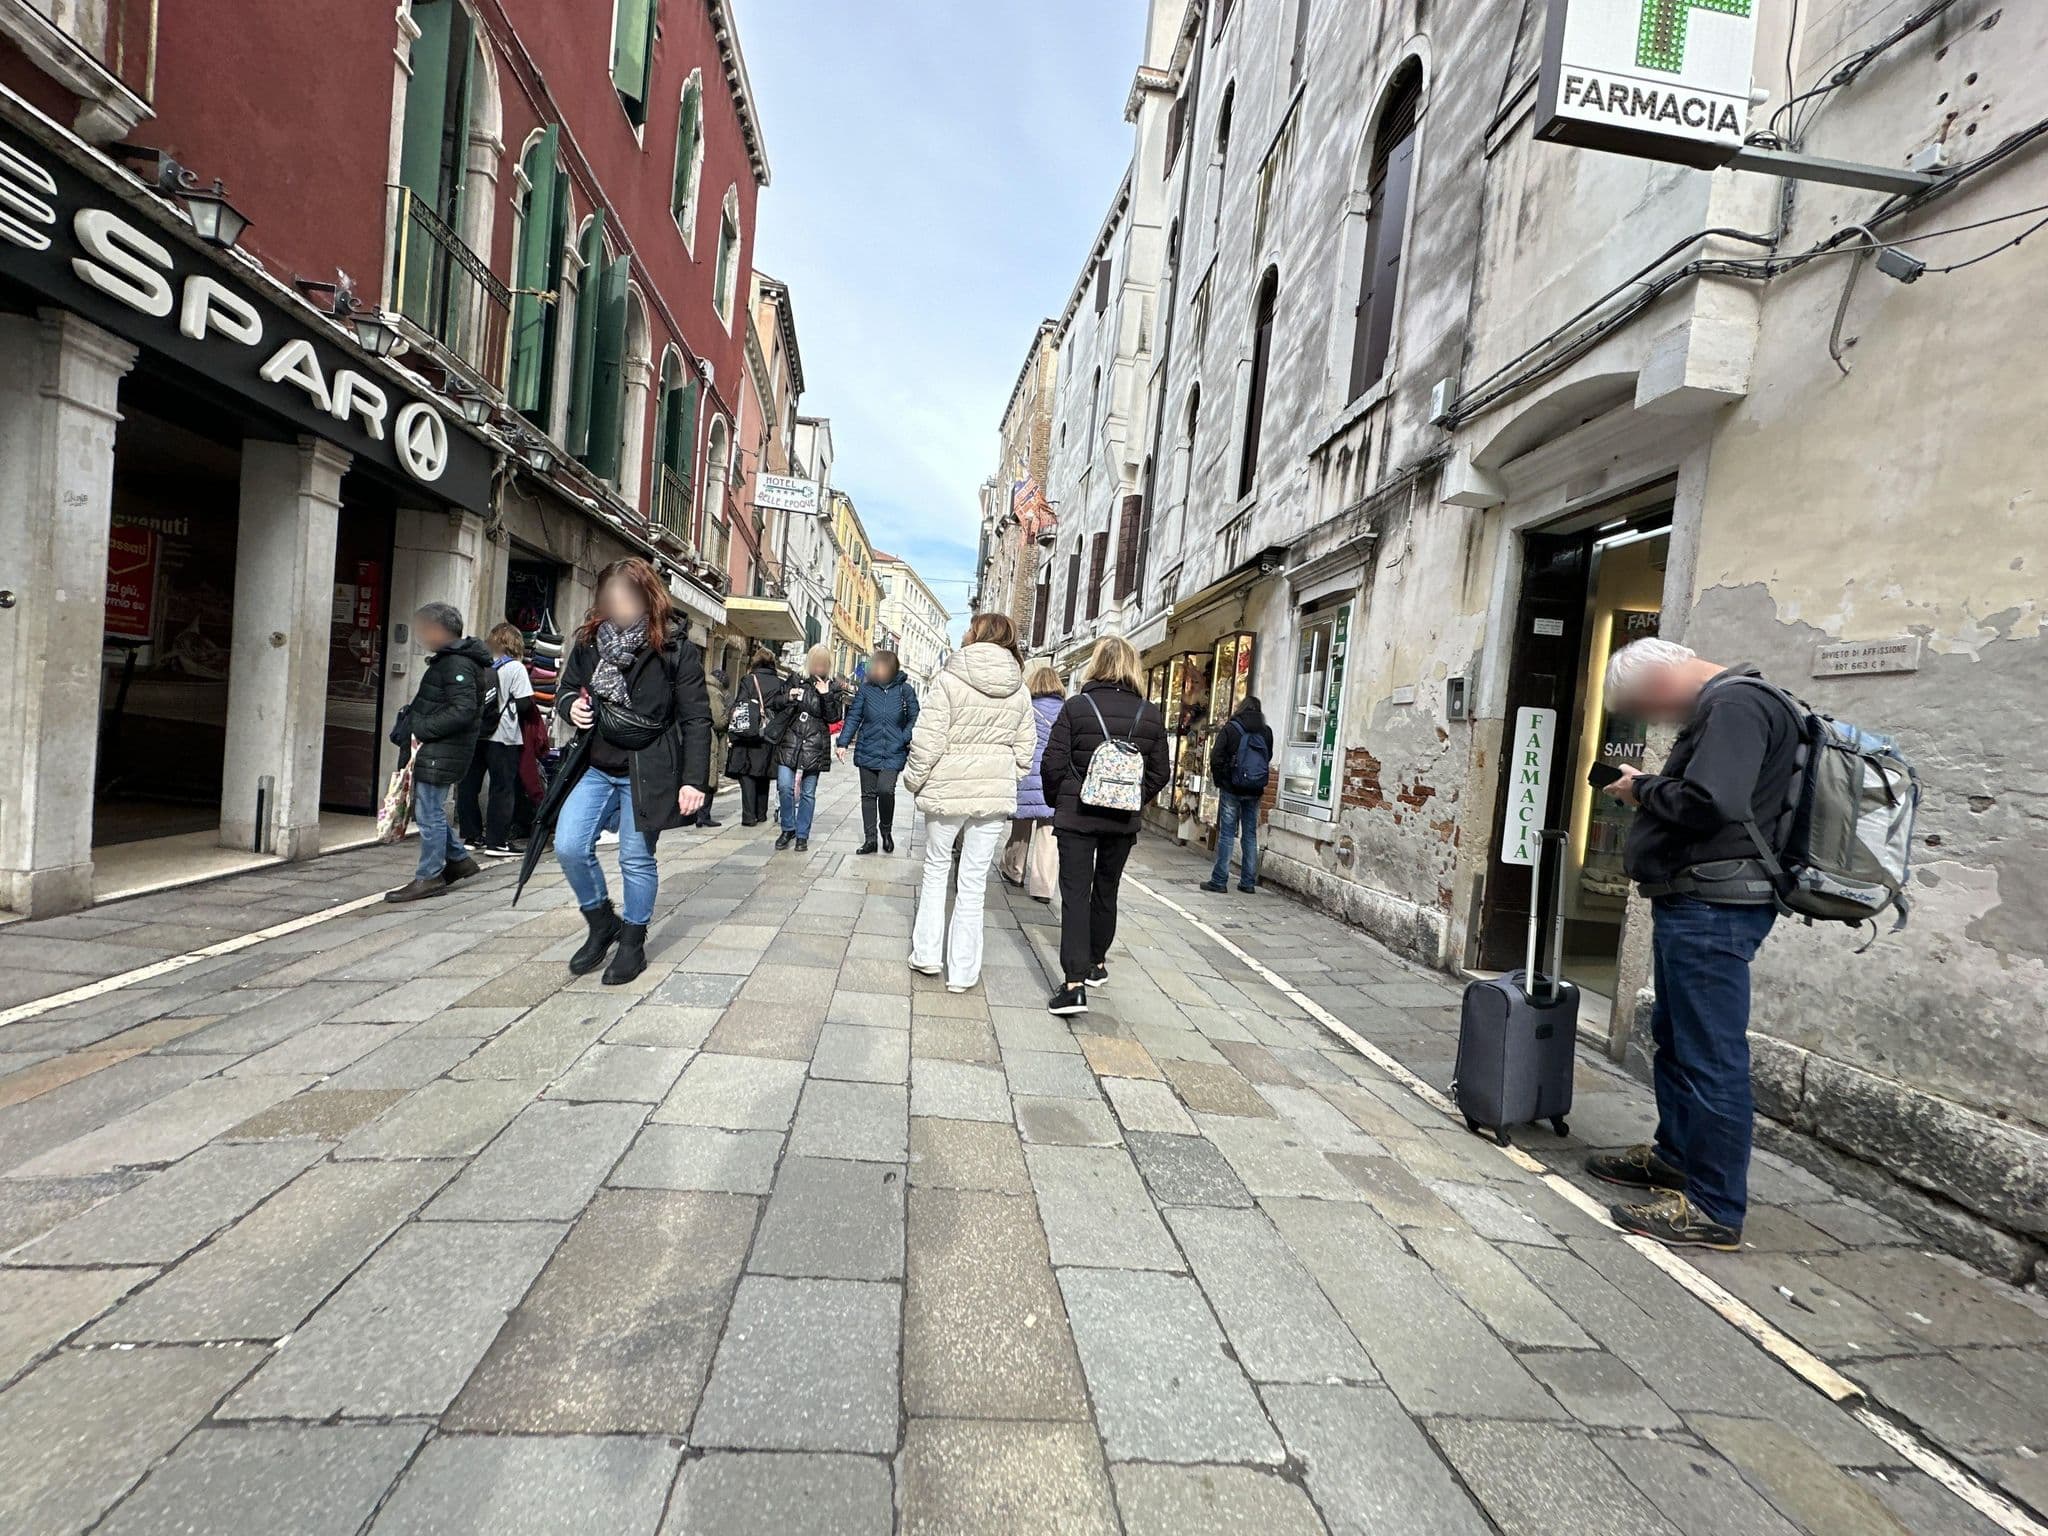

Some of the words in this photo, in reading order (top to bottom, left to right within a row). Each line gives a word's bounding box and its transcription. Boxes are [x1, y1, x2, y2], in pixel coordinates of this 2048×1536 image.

[1564, 75, 1742, 136] FARMACIA
[766, 476, 797, 488] HOTEL
[784, 499, 816, 509] EPOQUE
[1627, 613, 1659, 630] FAR
[1821, 649, 1849, 660] DIVIETO
[1852, 649, 1860, 658] DI
[1862, 644, 1908, 657] AFFISSIONE
[1604, 742, 1645, 758] SANT
[1513, 714, 1544, 859] FARMACIA
